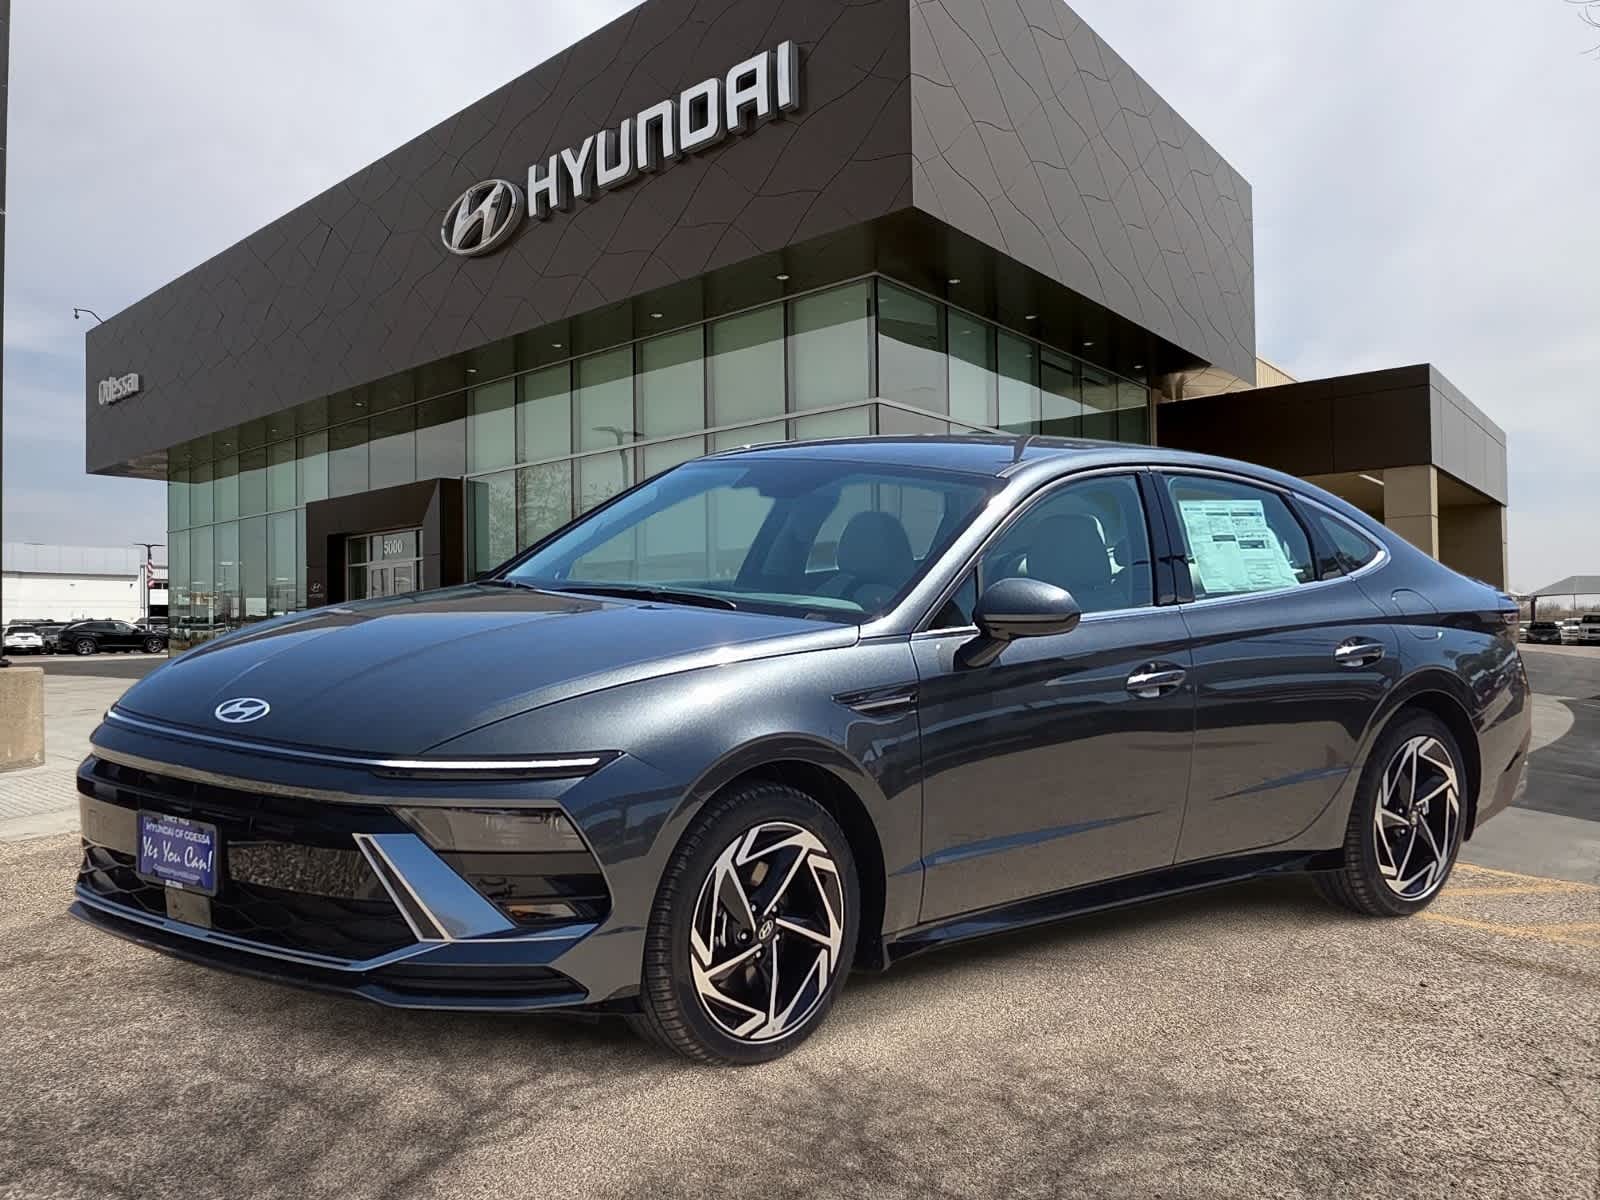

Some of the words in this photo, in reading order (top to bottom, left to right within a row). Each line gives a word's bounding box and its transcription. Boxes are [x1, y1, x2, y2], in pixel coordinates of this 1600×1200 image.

[528, 41, 799, 218] HYUNDAI
[383, 540, 403, 555] 5000
[175, 828, 184, 838] OF
[143, 836, 159, 859] Yes
[162, 840, 181, 863] You
[184, 846, 213, 872] Can!
